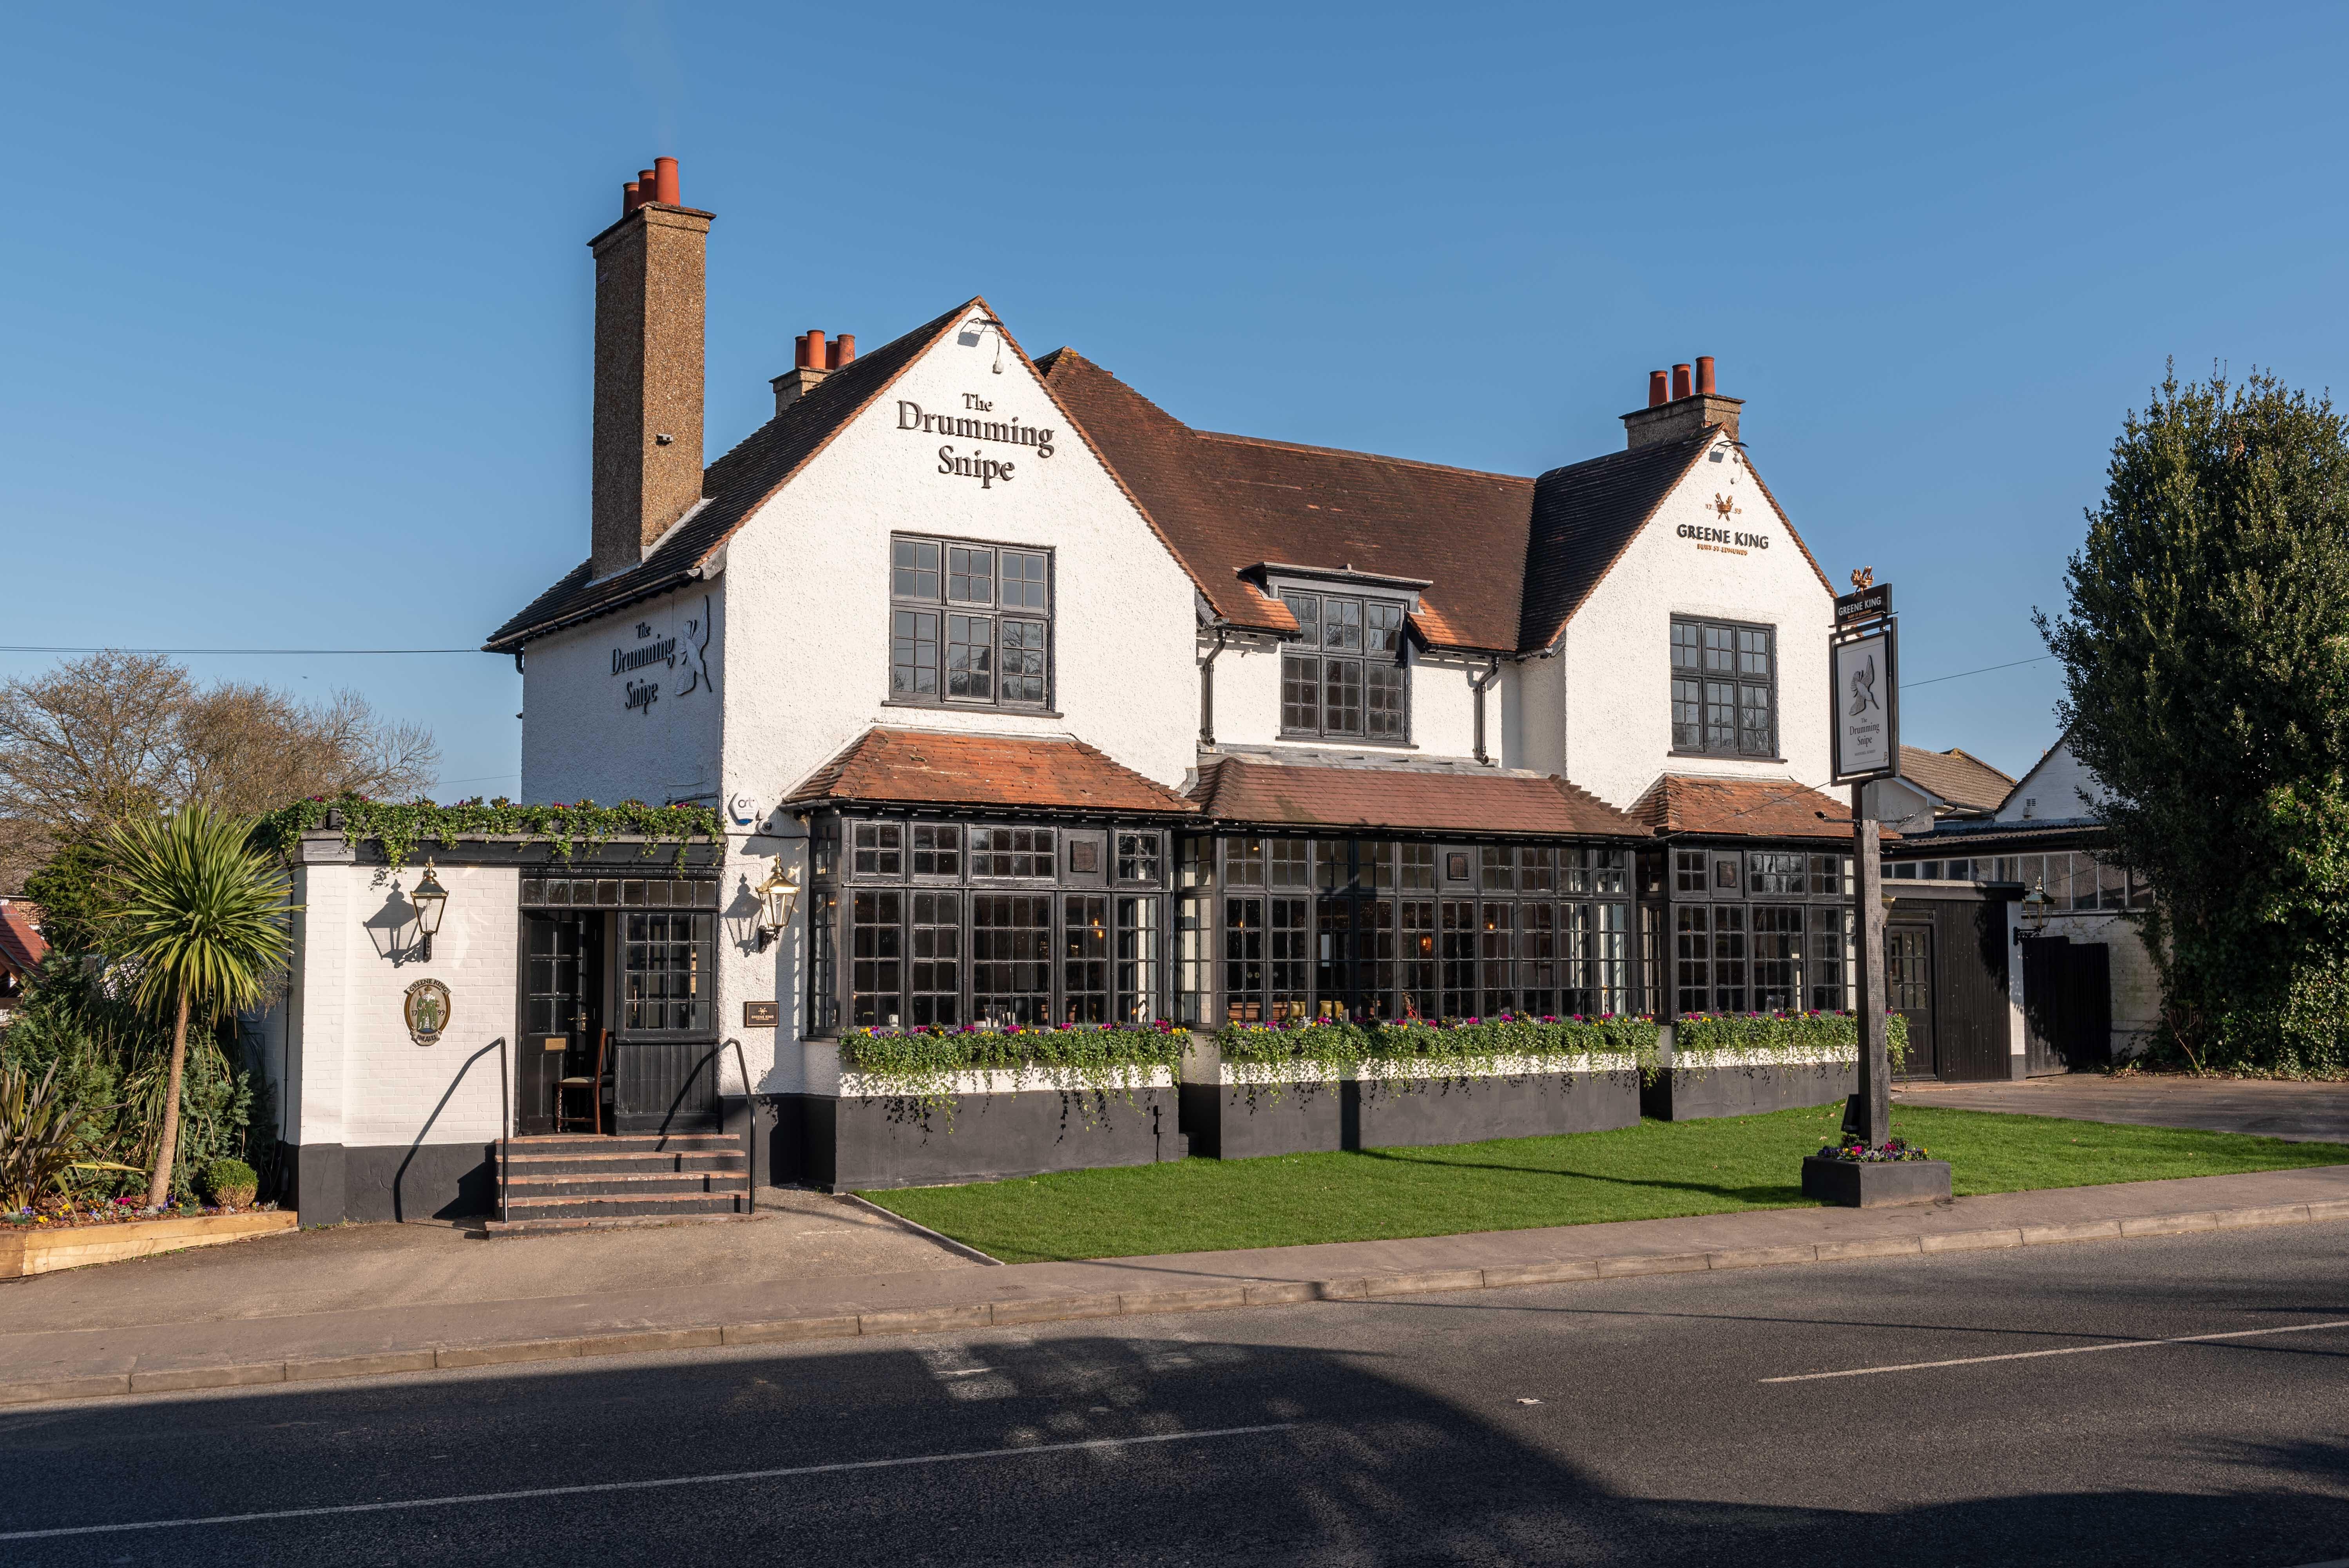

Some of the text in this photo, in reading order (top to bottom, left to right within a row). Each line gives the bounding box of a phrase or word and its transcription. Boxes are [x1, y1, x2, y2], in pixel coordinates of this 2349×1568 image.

[962, 393, 994, 412] The
[896, 400, 1054, 458] Drumming
[938, 445, 1015, 489] Snipe
[1677, 524, 1769, 549] GREENE KING
[1721, 547, 1748, 556] EDMUNDS
[1838, 596, 1881, 616] GREENE KING
[636, 622, 651, 639] The
[610, 634, 675, 675] Drumming
[625, 679, 658, 714] Snipe
[1850, 722, 1880, 735] Drumming
[1857, 735, 1872, 747] Snipe
[409, 979, 448, 992] GREENE KING
